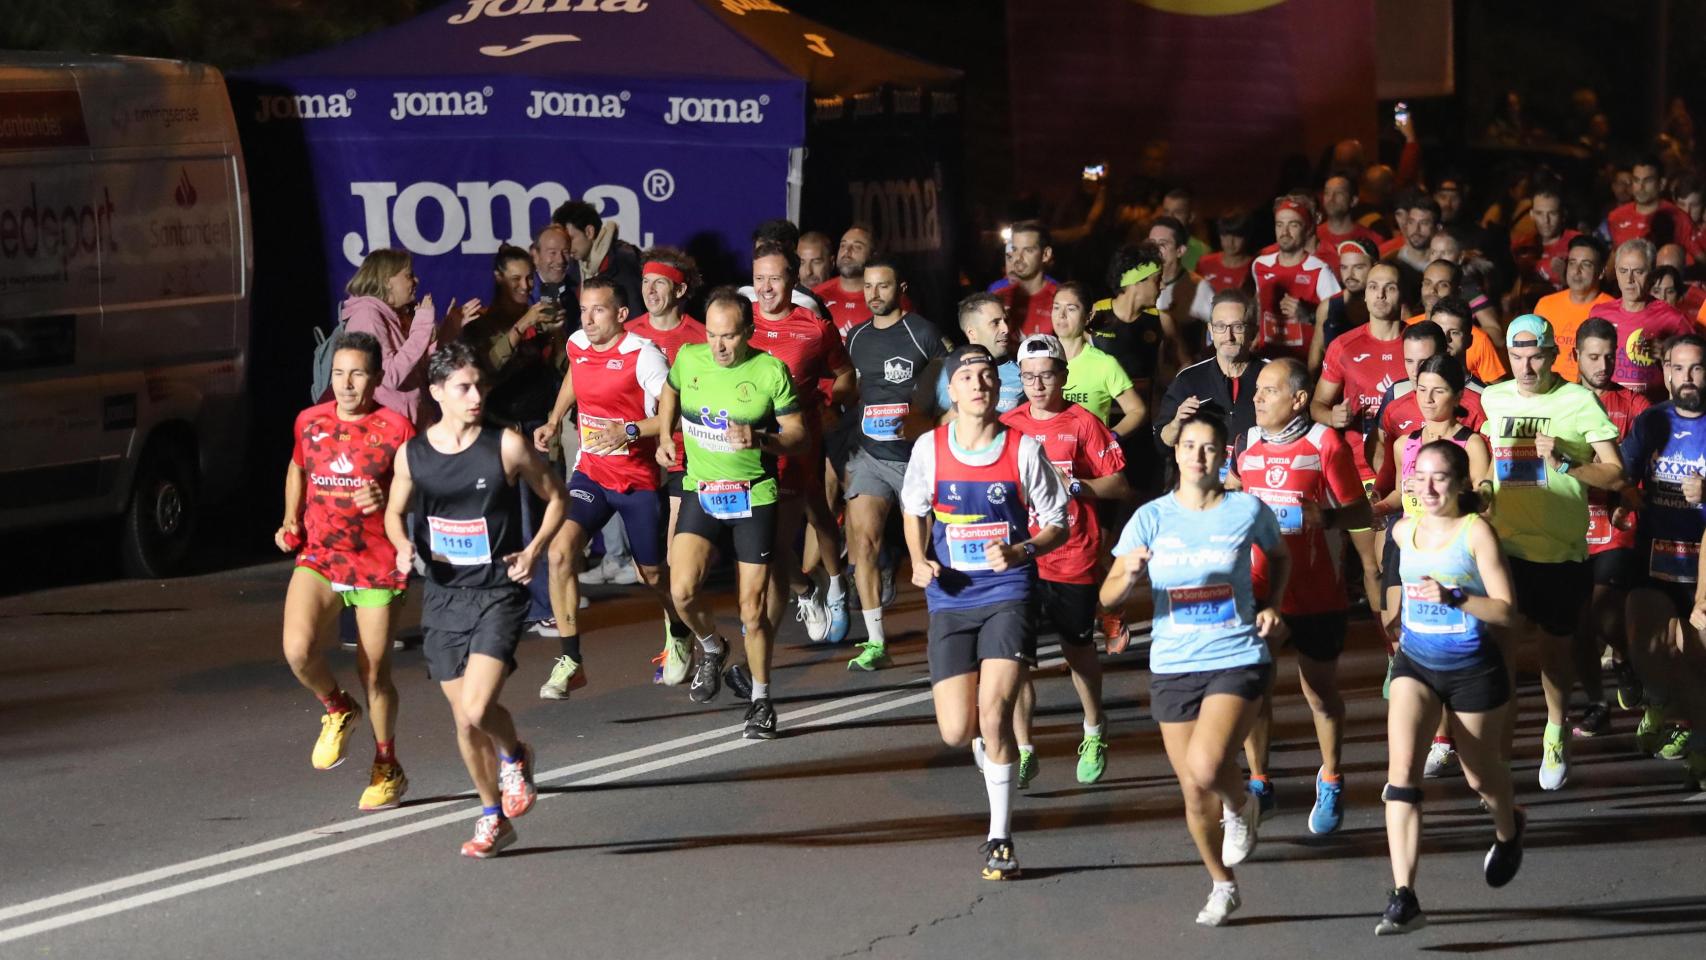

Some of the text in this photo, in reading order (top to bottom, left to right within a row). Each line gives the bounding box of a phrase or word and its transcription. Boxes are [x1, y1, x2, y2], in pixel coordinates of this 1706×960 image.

[767, 331, 779, 339] RR
[872, 407, 908, 416] Santander
[1511, 417, 1550, 438] RUN
[711, 494, 738, 505] 1812
[960, 527, 1007, 538] Santander
[442, 537, 473, 549] 1116
[960, 542, 985, 554] 131
[1184, 587, 1231, 600] Santander
[1185, 602, 1219, 616] 3725
[1416, 604, 1448, 616] 3726
